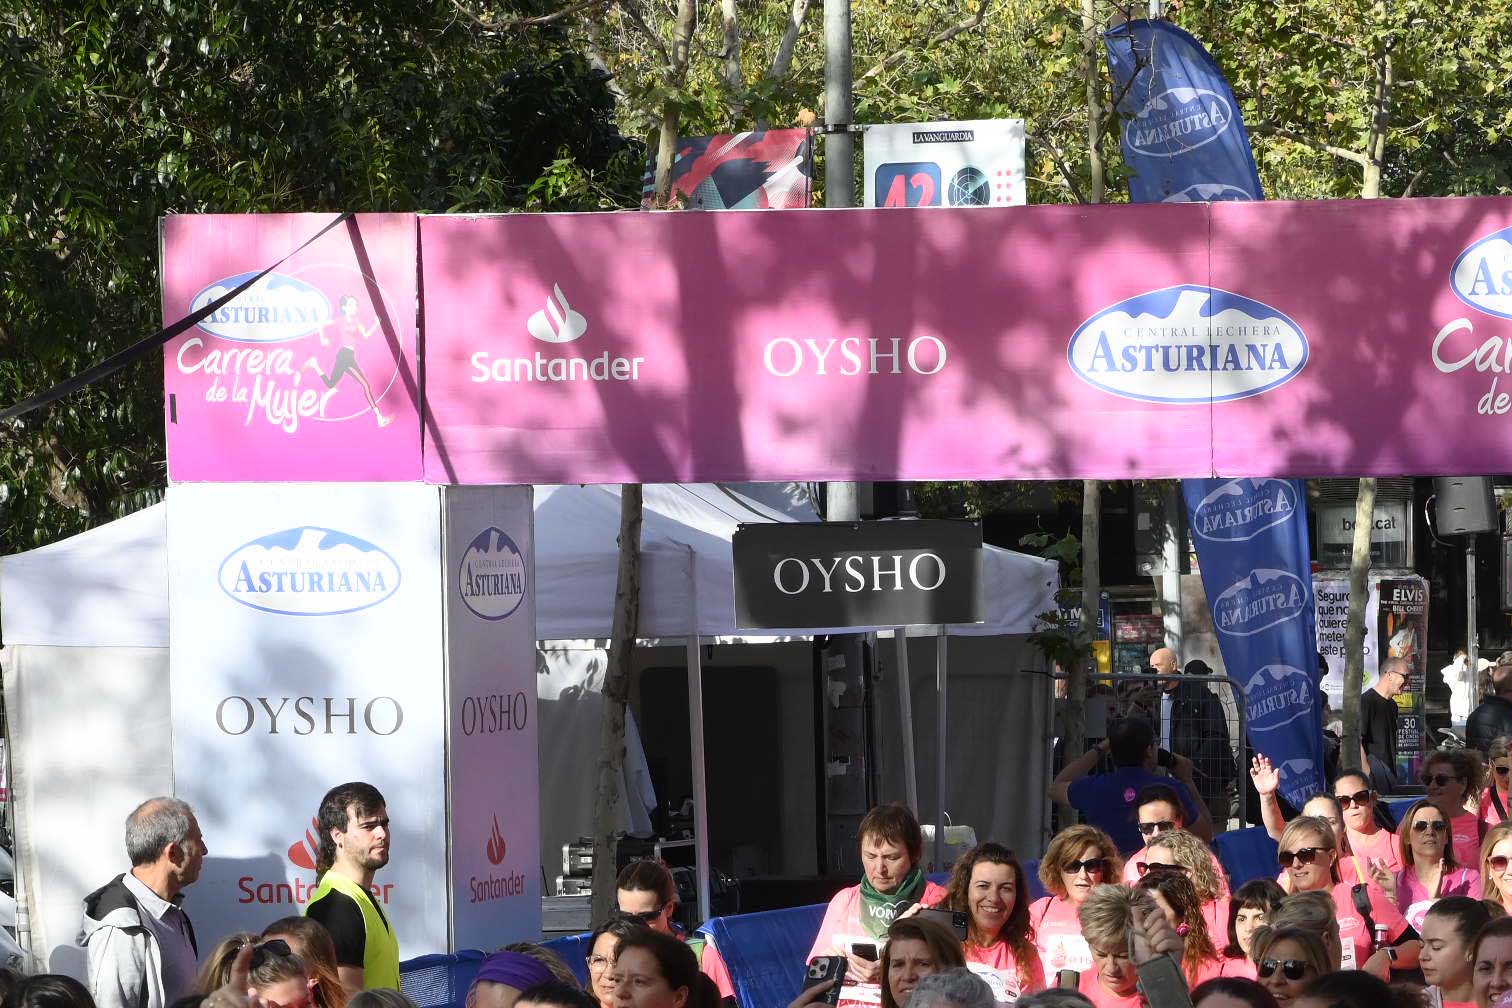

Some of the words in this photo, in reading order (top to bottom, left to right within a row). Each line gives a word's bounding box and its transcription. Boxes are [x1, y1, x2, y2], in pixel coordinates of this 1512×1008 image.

[200, 297, 320, 324] ASTURIANA
[1124, 327, 1199, 338] CENTRAL
[1206, 325, 1281, 337] LECHERA
[176, 337, 295, 375] Carrera
[470, 350, 645, 382] Santander
[762, 336, 947, 377] OYSHO
[1087, 331, 1290, 373] ASTURIANA
[206, 377, 227, 403] de
[232, 375, 248, 402] la
[244, 369, 340, 434] Mujer
[1478, 377, 1511, 414] de
[232, 559, 388, 594] ASTURIANA
[465, 562, 523, 598] ASTURIANA
[773, 553, 946, 594] OYSHO
[1319, 605, 1335, 618] que
[1393, 588, 1423, 602] ELVIS
[1319, 617, 1351, 631] quiere
[1320, 647, 1338, 655] este
[216, 695, 404, 735] OYSHO
[462, 692, 528, 736] OYSHO
[1404, 718, 1416, 729] 30
[238, 875, 394, 904] Santer
[470, 871, 525, 903] Santander
